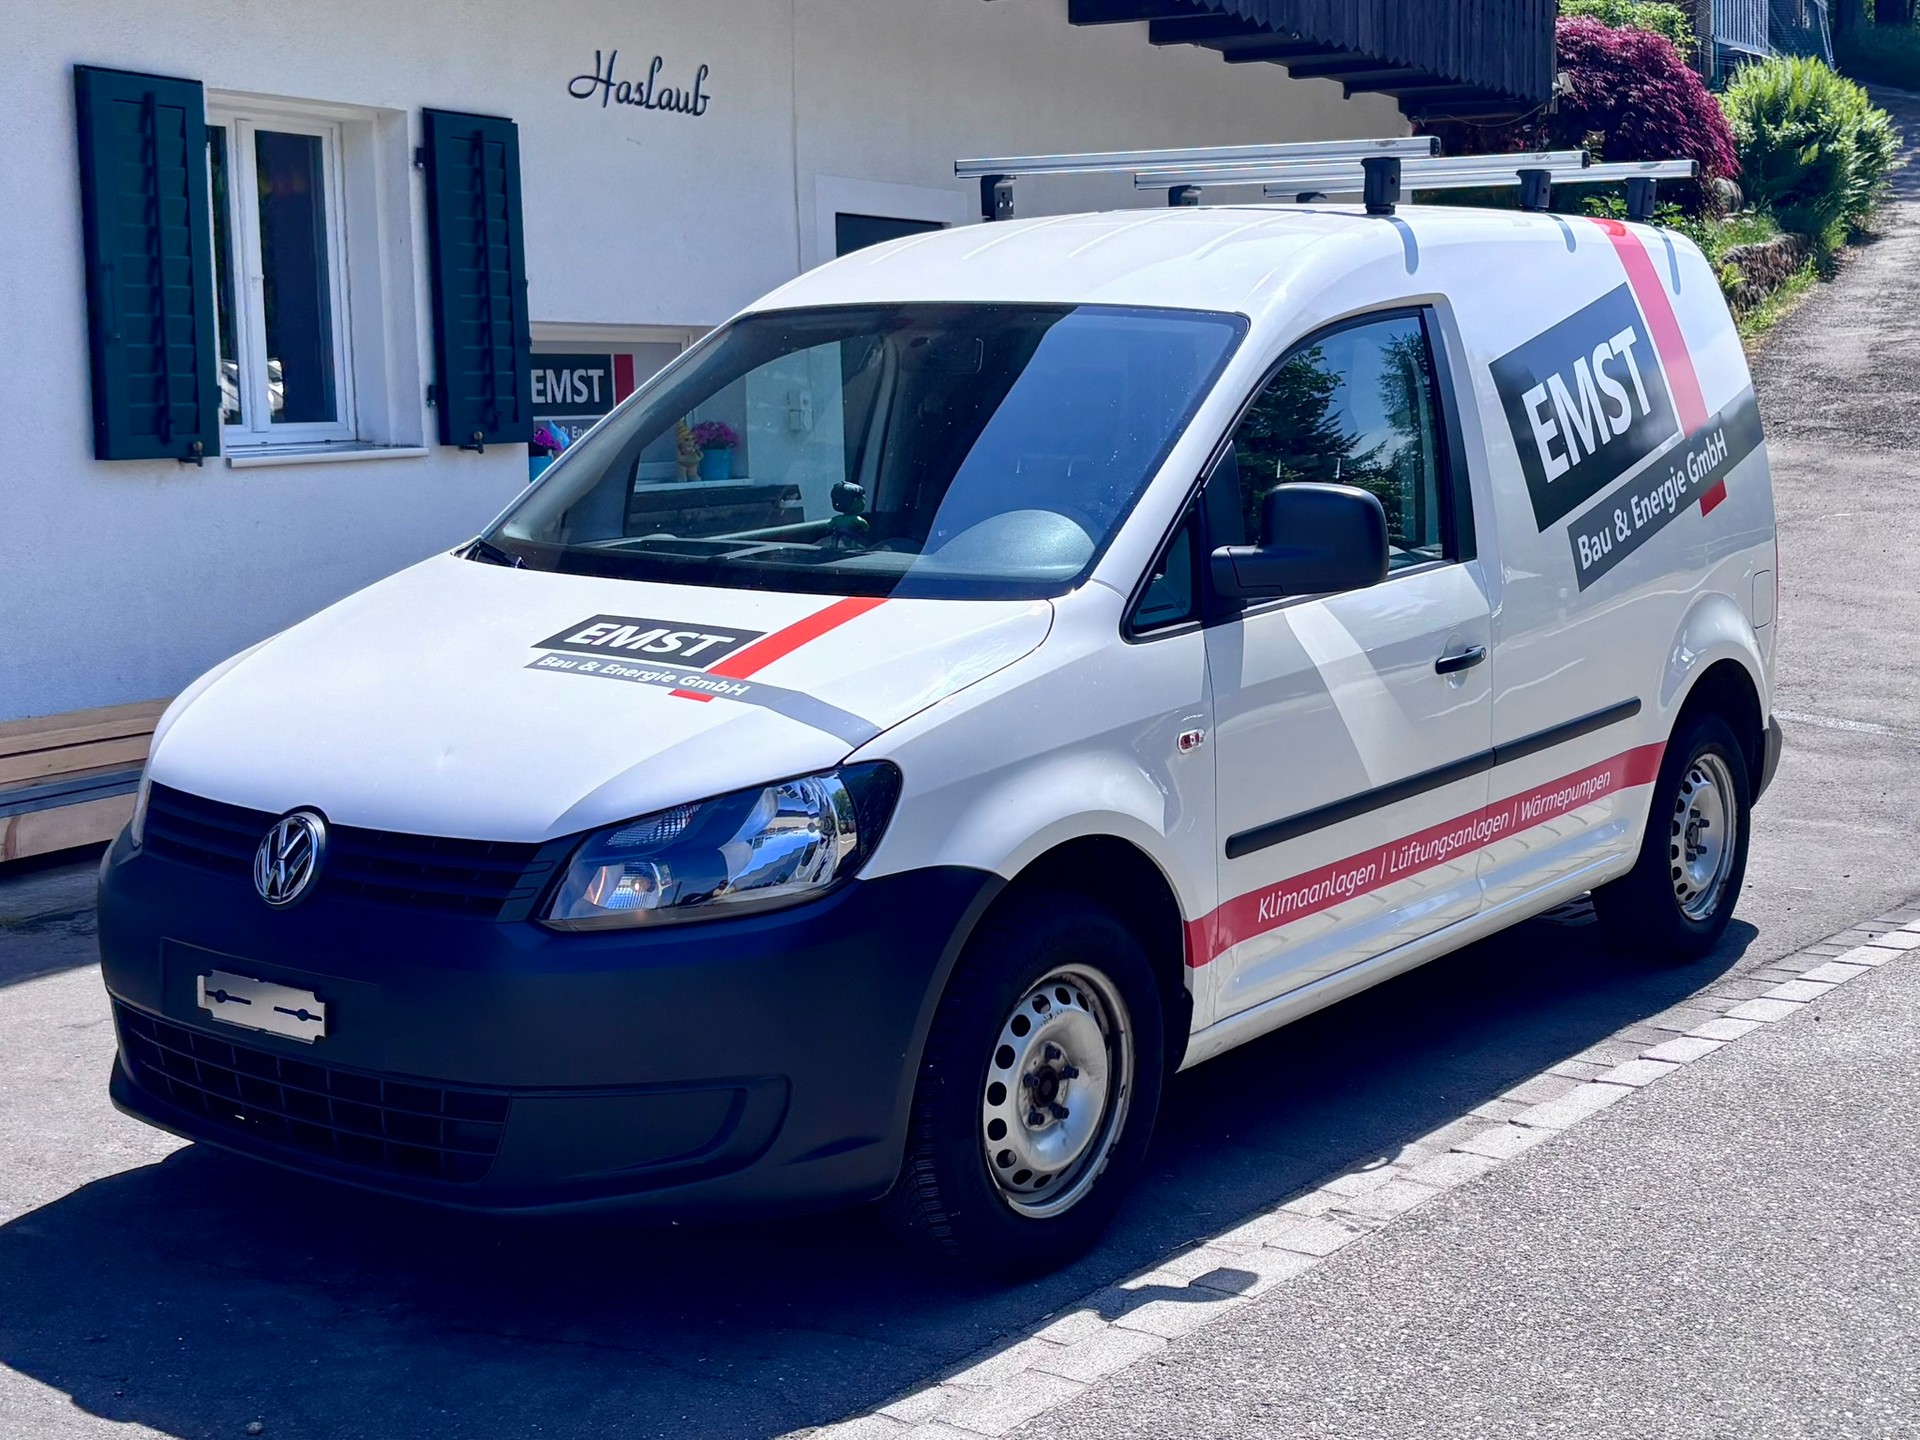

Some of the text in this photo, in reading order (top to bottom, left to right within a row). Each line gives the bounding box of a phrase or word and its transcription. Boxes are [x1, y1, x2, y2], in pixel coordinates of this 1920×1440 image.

[530, 369, 604, 403] EMST
[1521, 325, 1651, 483] EMST
[1577, 428, 1728, 570] Bau & Energie GmbH
[537, 656, 751, 697] Bau & Energie GmbH
[564, 622, 735, 658] EMST
[1258, 863, 1376, 923] Klimaanlagen
[1390, 812, 1509, 873] Lüftungsanlagen
[1521, 770, 1611, 821] Wärmepumpen
